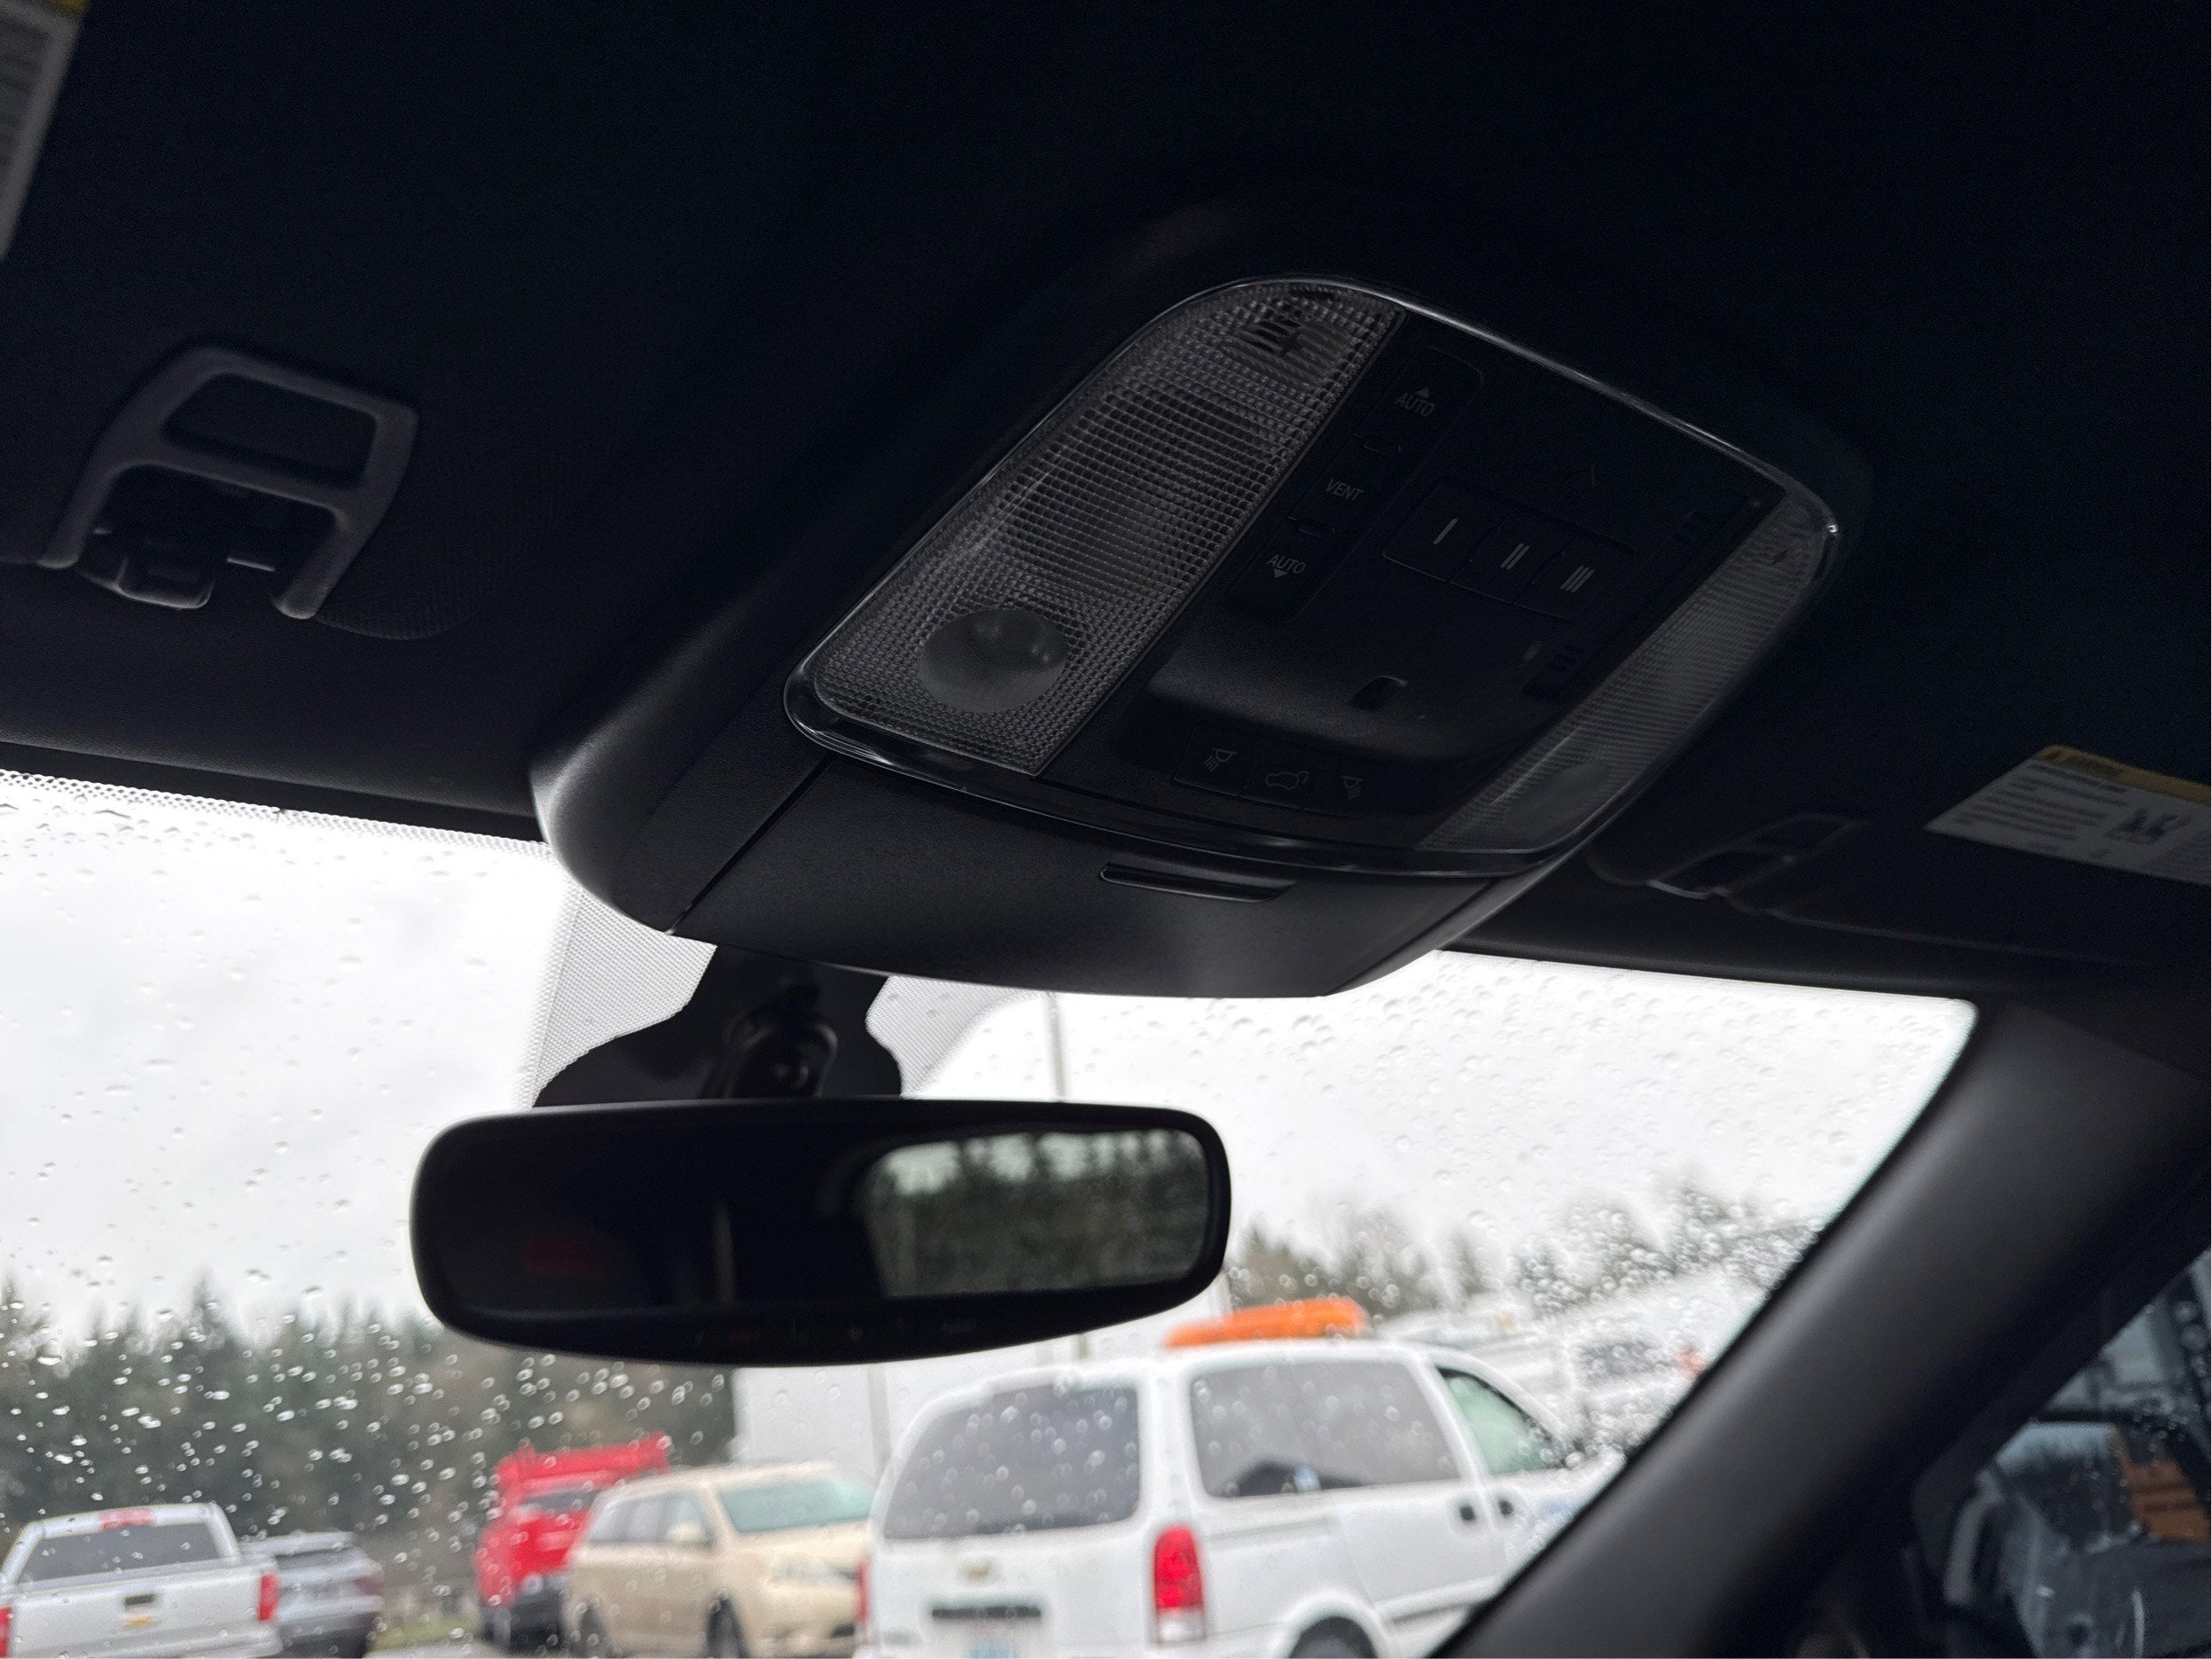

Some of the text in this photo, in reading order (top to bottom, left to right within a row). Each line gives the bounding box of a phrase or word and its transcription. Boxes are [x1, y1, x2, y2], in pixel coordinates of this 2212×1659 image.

[1394, 392, 1435, 417] AUTO
[1325, 478, 1364, 502] VENT
[1266, 553, 1306, 575] AUTO
